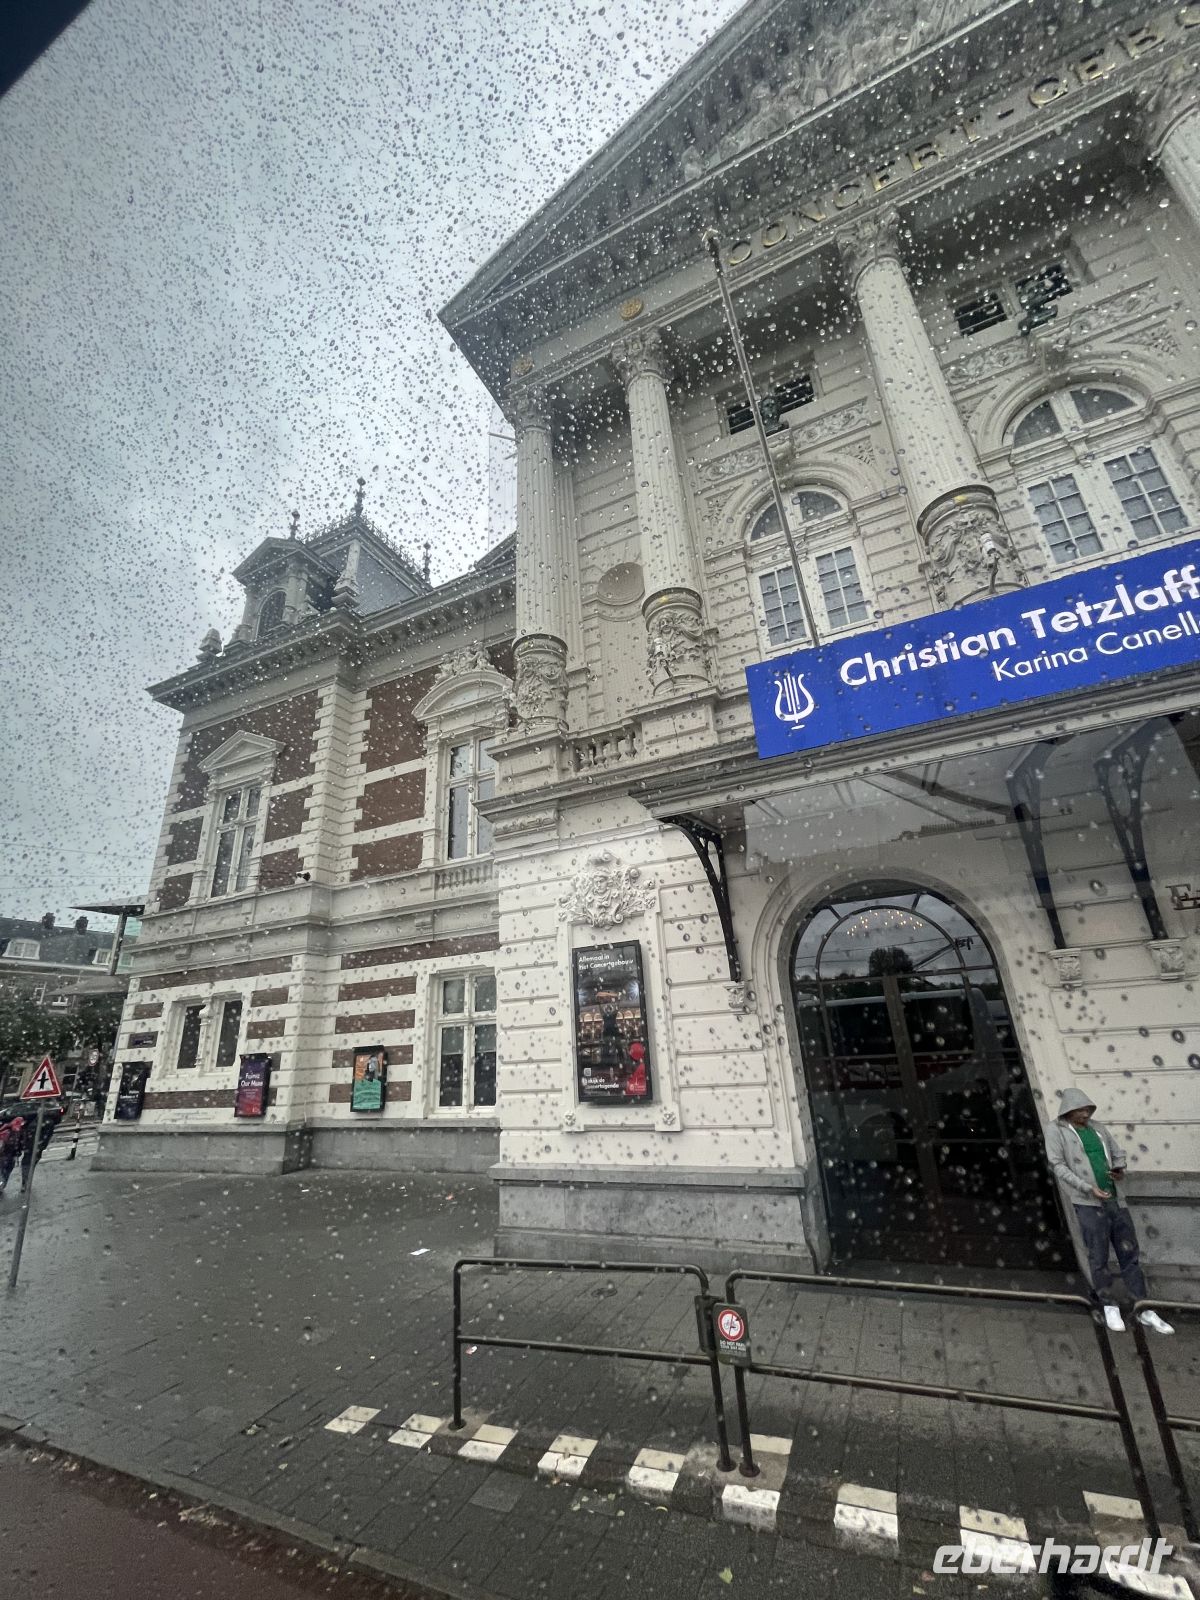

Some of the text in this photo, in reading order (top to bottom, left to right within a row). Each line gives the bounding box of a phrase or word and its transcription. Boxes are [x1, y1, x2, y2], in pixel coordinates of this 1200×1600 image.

[840, 564, 1200, 687] Christian Tetzlaff
[992, 611, 1200, 682] Karina Canell
